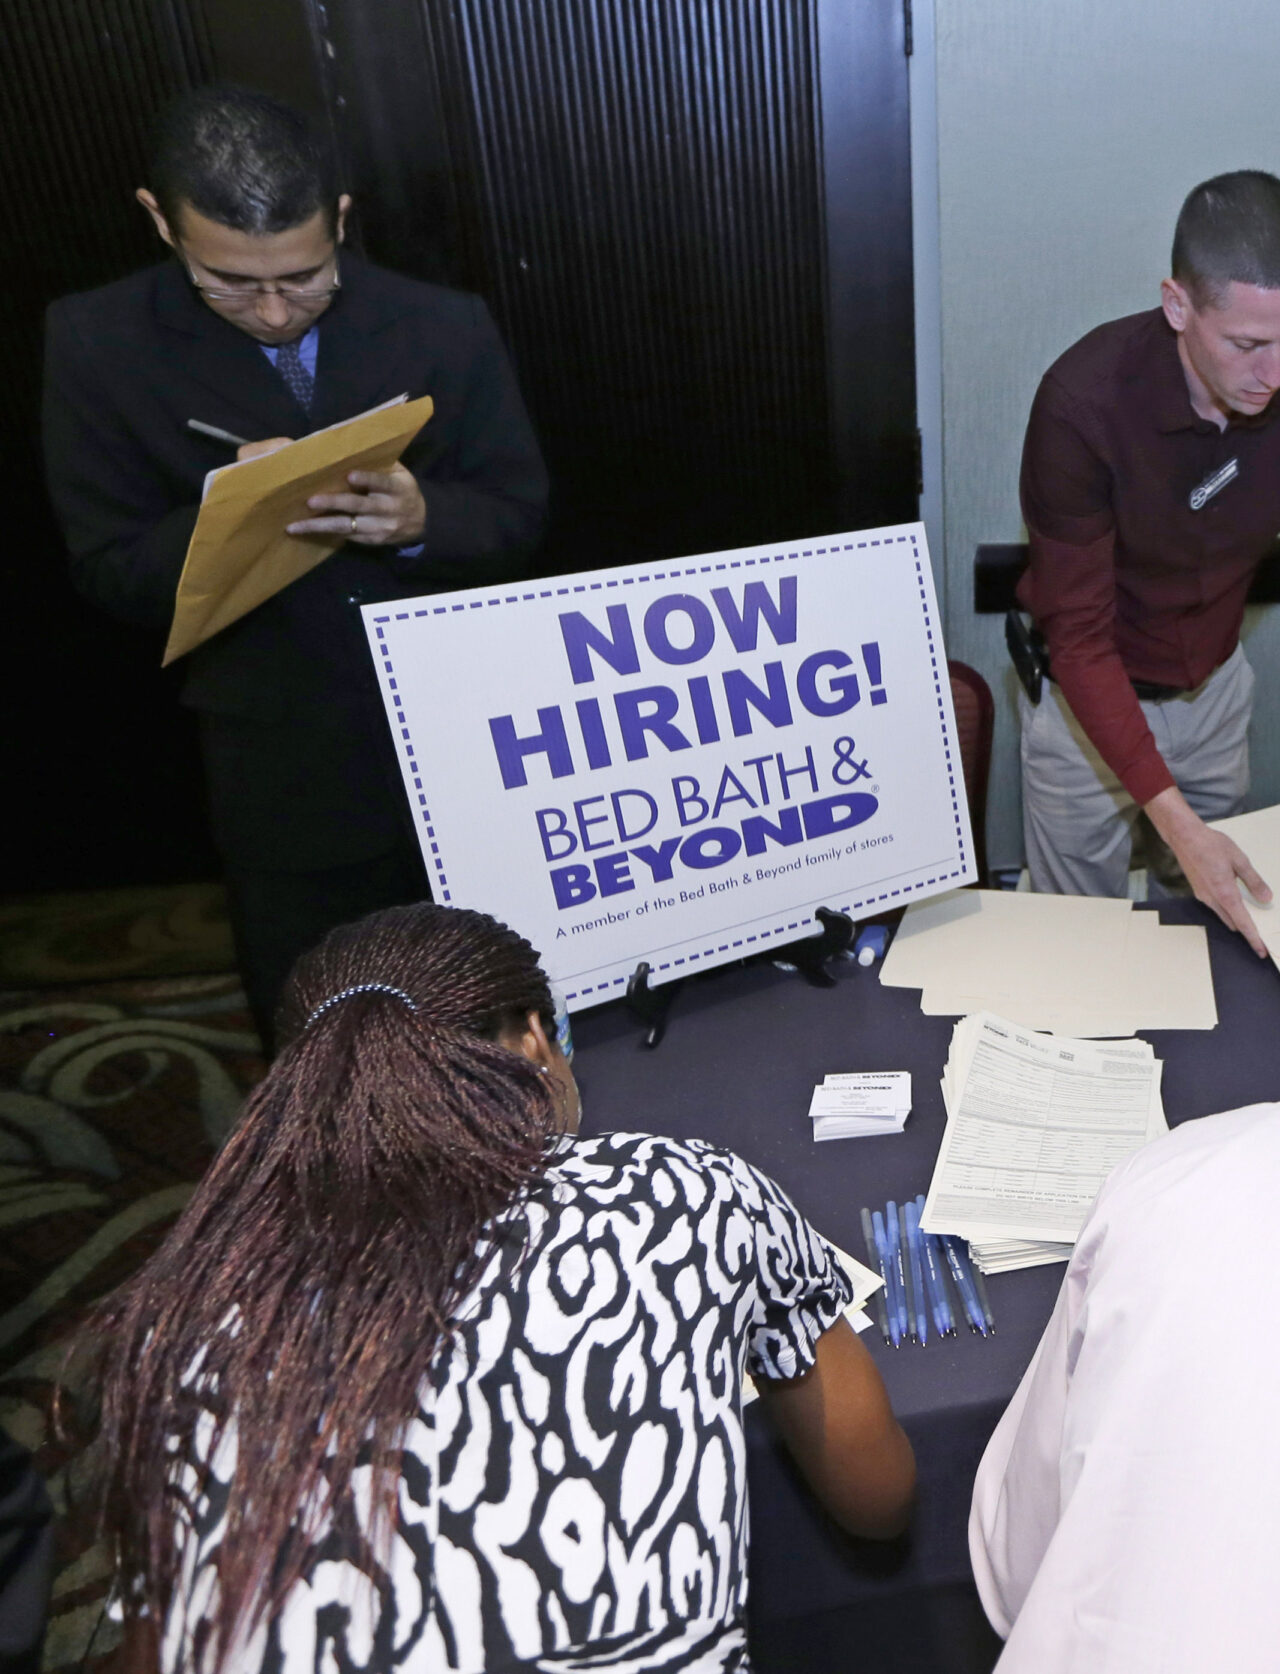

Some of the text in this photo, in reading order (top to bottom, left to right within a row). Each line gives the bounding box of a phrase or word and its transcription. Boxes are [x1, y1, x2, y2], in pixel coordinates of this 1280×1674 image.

[559, 576, 797, 685] NOW
[488, 642, 888, 790] HIRING!
[535, 735, 873, 863] BED BATH &
[550, 791, 879, 911] BEYOND
[555, 835, 894, 940] A member of the Bed Bath & Beyond family of stores
